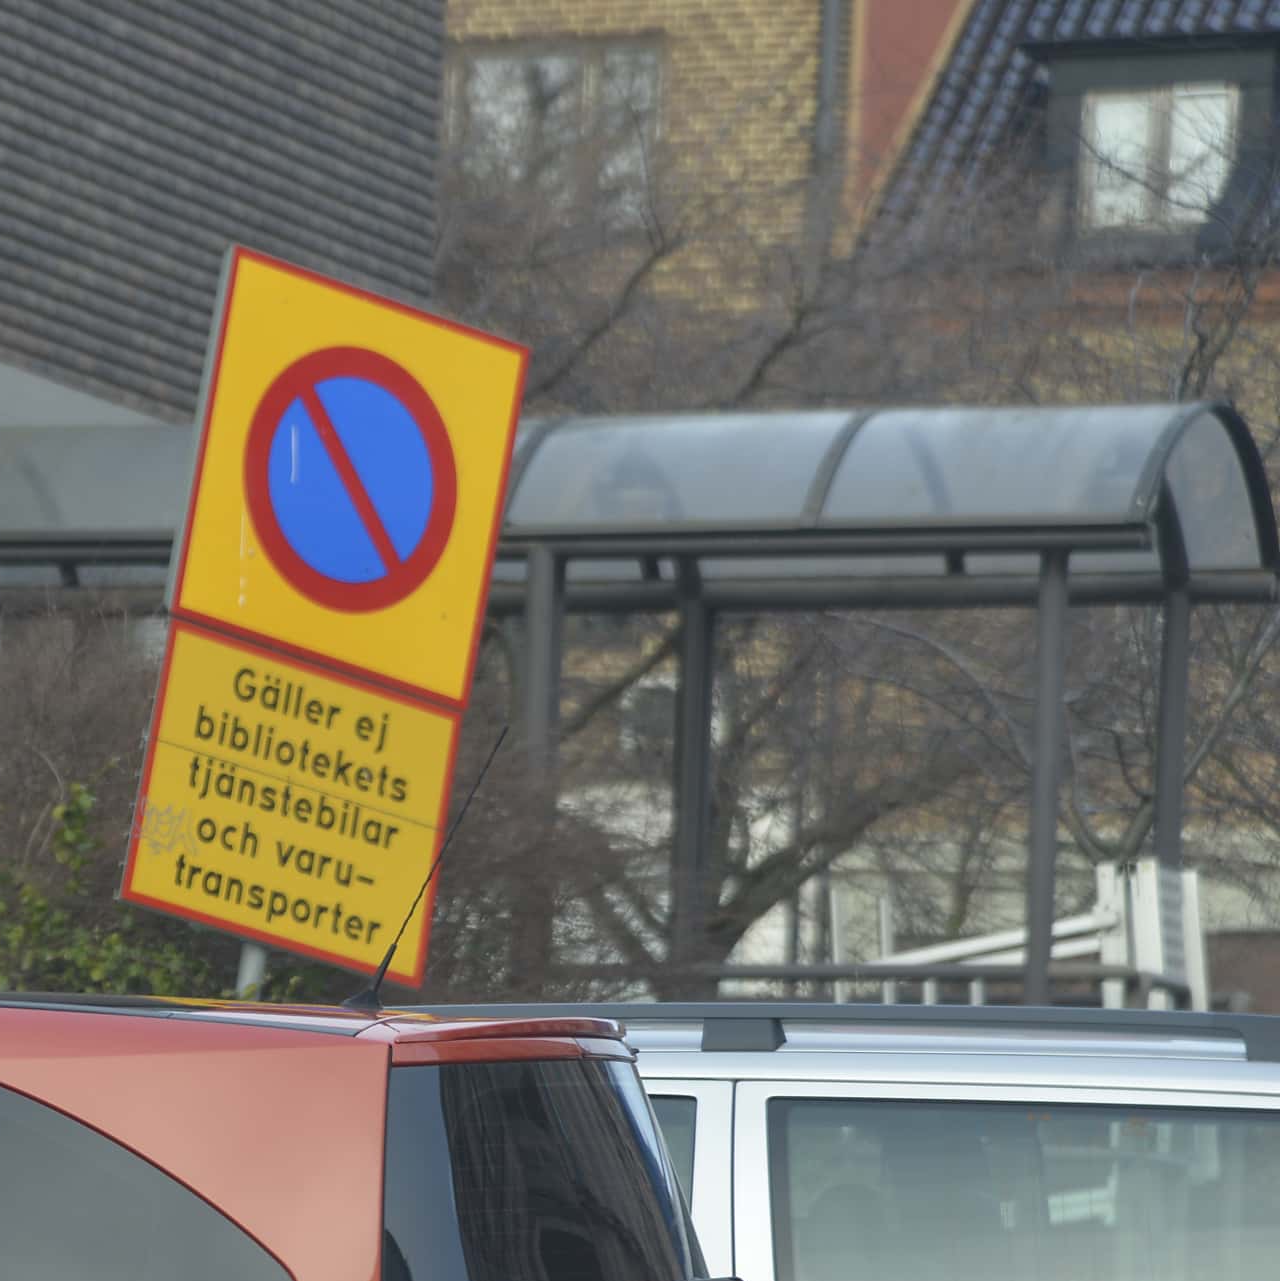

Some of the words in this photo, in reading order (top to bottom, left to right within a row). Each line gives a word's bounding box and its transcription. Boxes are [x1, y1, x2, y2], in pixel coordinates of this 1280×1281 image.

[194, 705, 408, 802] bibliotekets
[233, 668, 342, 730] Gäller
[355, 713, 389, 752] ej
[189, 756, 399, 850] tjänstebilar
[197, 817, 259, 857] och
[276, 840, 374, 889] varu-
[175, 854, 382, 945] transporter
